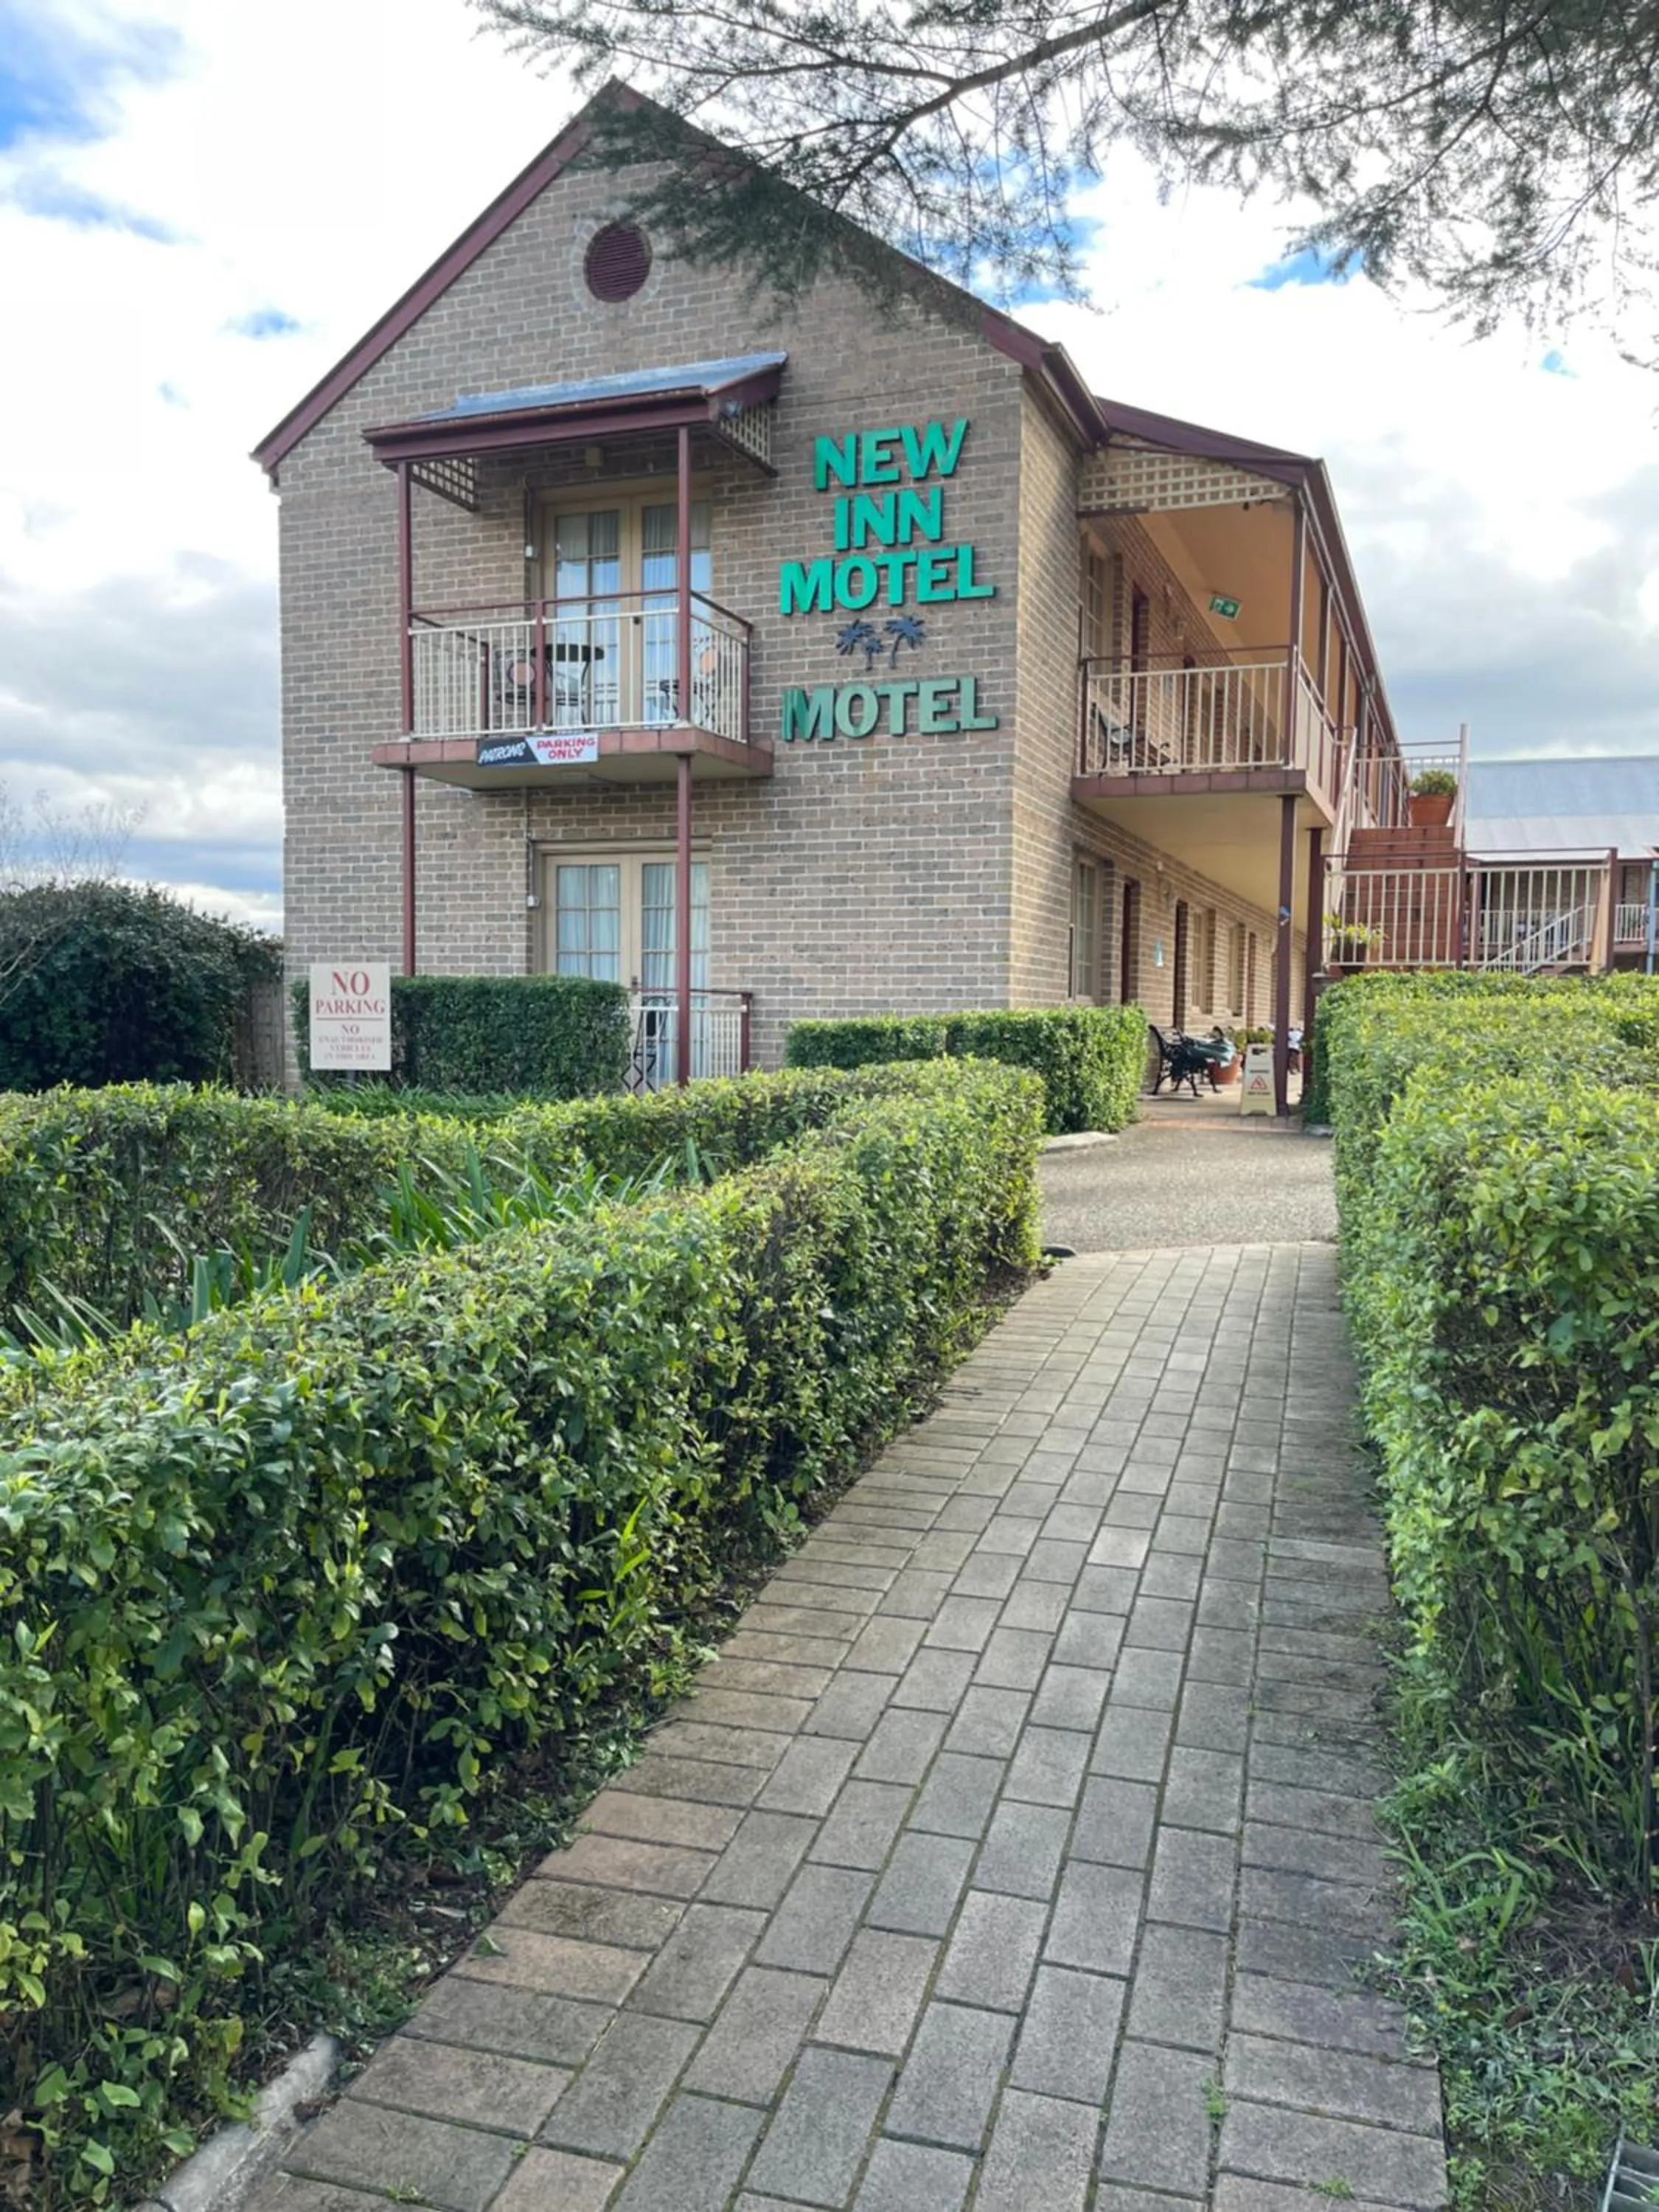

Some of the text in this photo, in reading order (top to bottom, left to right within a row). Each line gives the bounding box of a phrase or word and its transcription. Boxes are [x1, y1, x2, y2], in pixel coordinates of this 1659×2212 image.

[815, 418, 968, 490] NEW
[834, 487, 944, 550] INN
[779, 543, 996, 614] MOTEL
[782, 677, 998, 742] MOTEL
[537, 737, 596, 749] PARKING
[548, 748, 582, 759] ONLY
[332, 971, 370, 995] NO
[316, 999, 385, 1014] PARKING
[341, 1024, 360, 1034] NO
